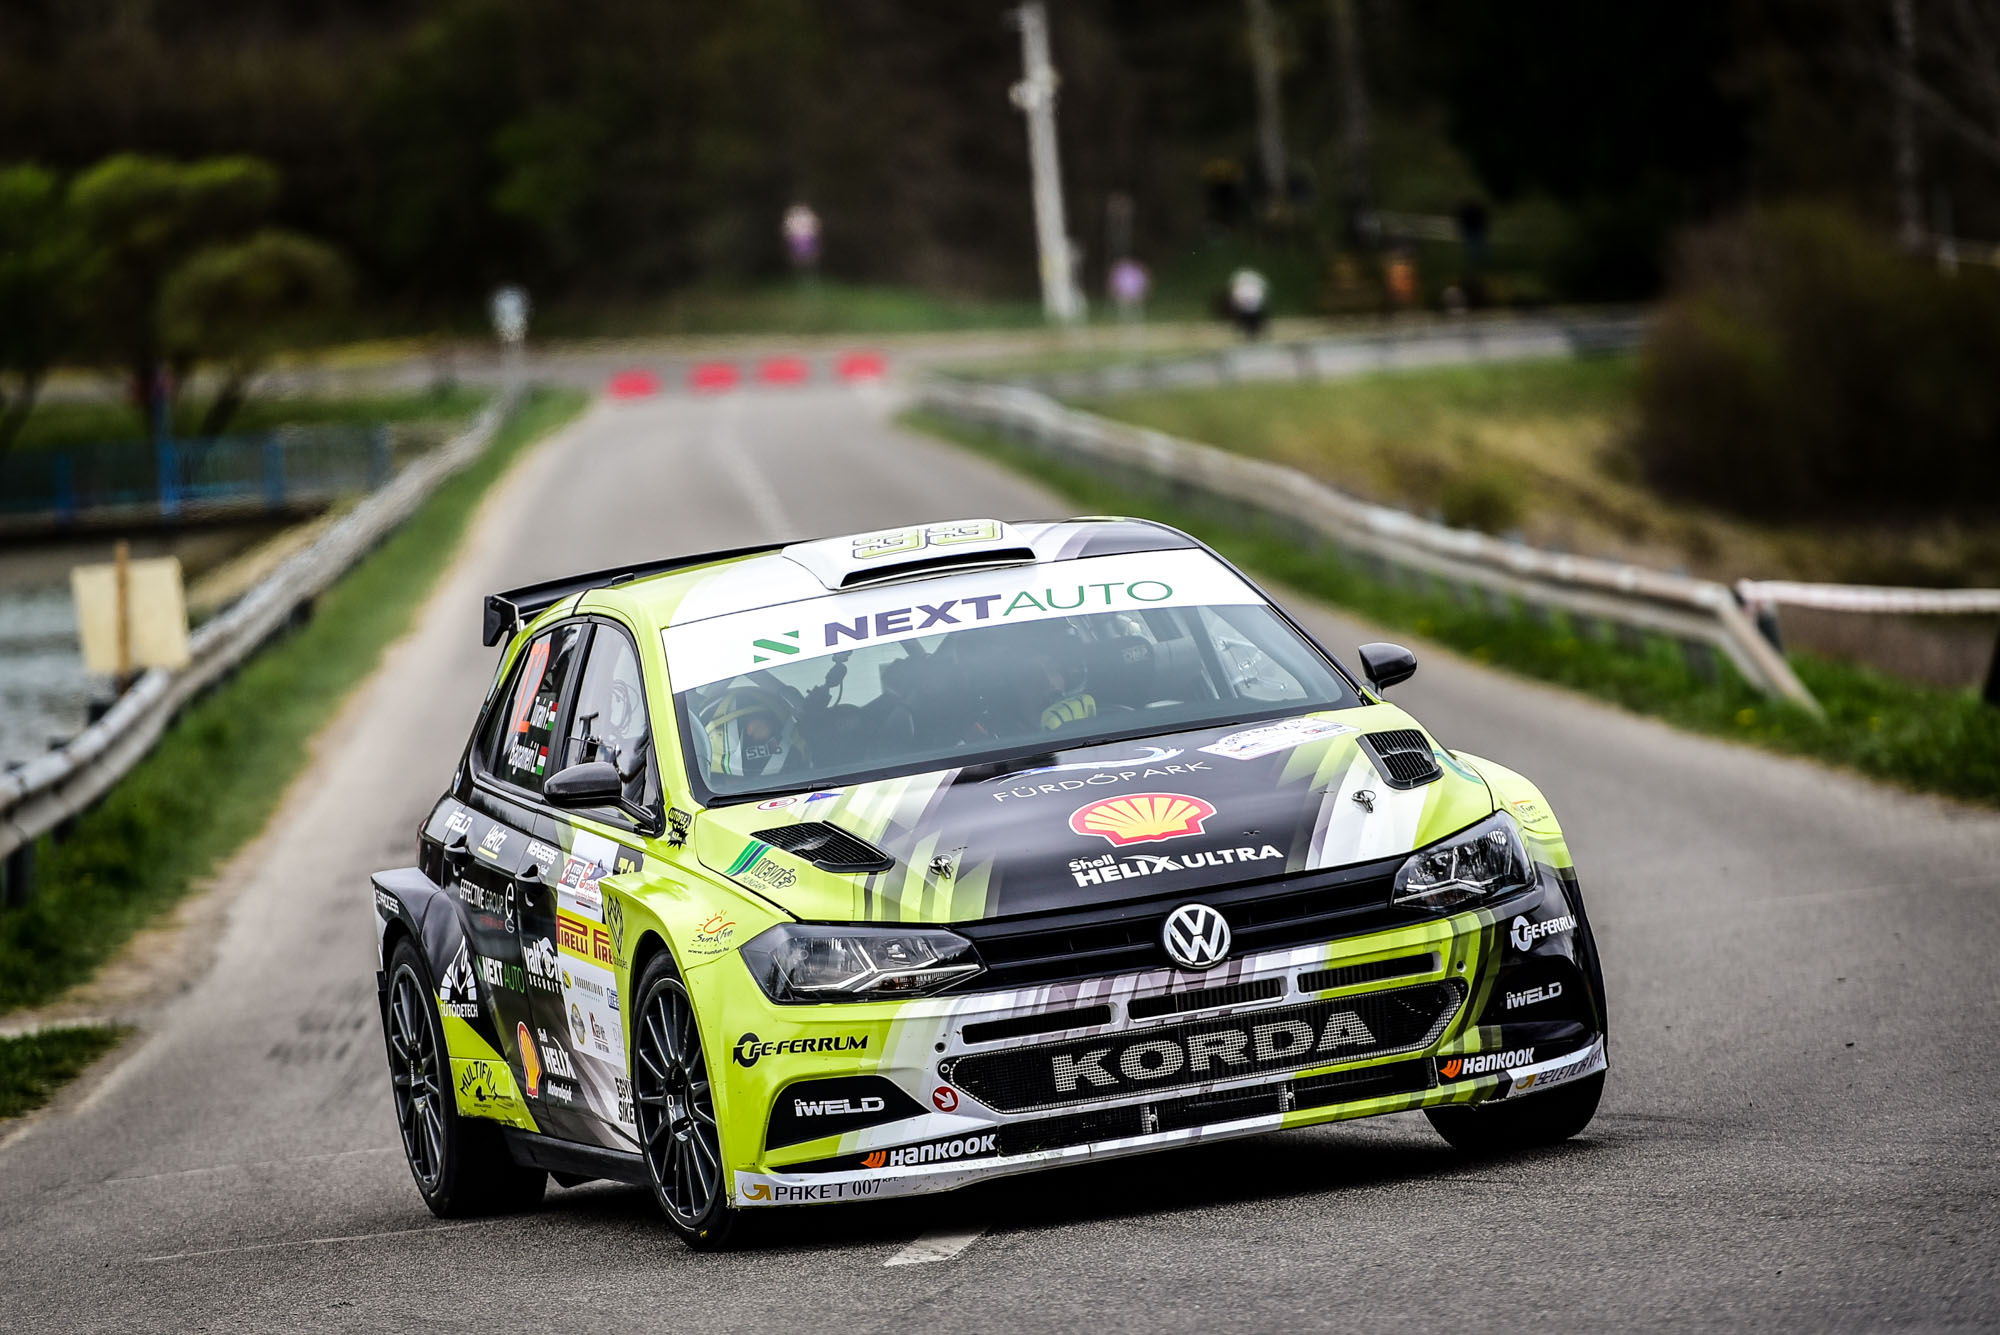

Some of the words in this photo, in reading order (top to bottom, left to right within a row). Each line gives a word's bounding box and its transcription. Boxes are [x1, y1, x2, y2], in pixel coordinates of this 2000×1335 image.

[481, 824, 507, 853] Hertz
[1068, 854, 1115, 872] Shell
[1072, 855, 1184, 888] HELIX
[1181, 845, 1284, 868] ULTRA
[460, 879, 485, 910] EFFECTIVE
[485, 890, 504, 915] GROUP
[556, 914, 588, 955] PIRELLI
[541, 1043, 577, 1080] HELIX
[1051, 1010, 1377, 1094] KORDA
[775, 1182, 847, 1201] PAKET
[852, 1178, 881, 1196] 007
